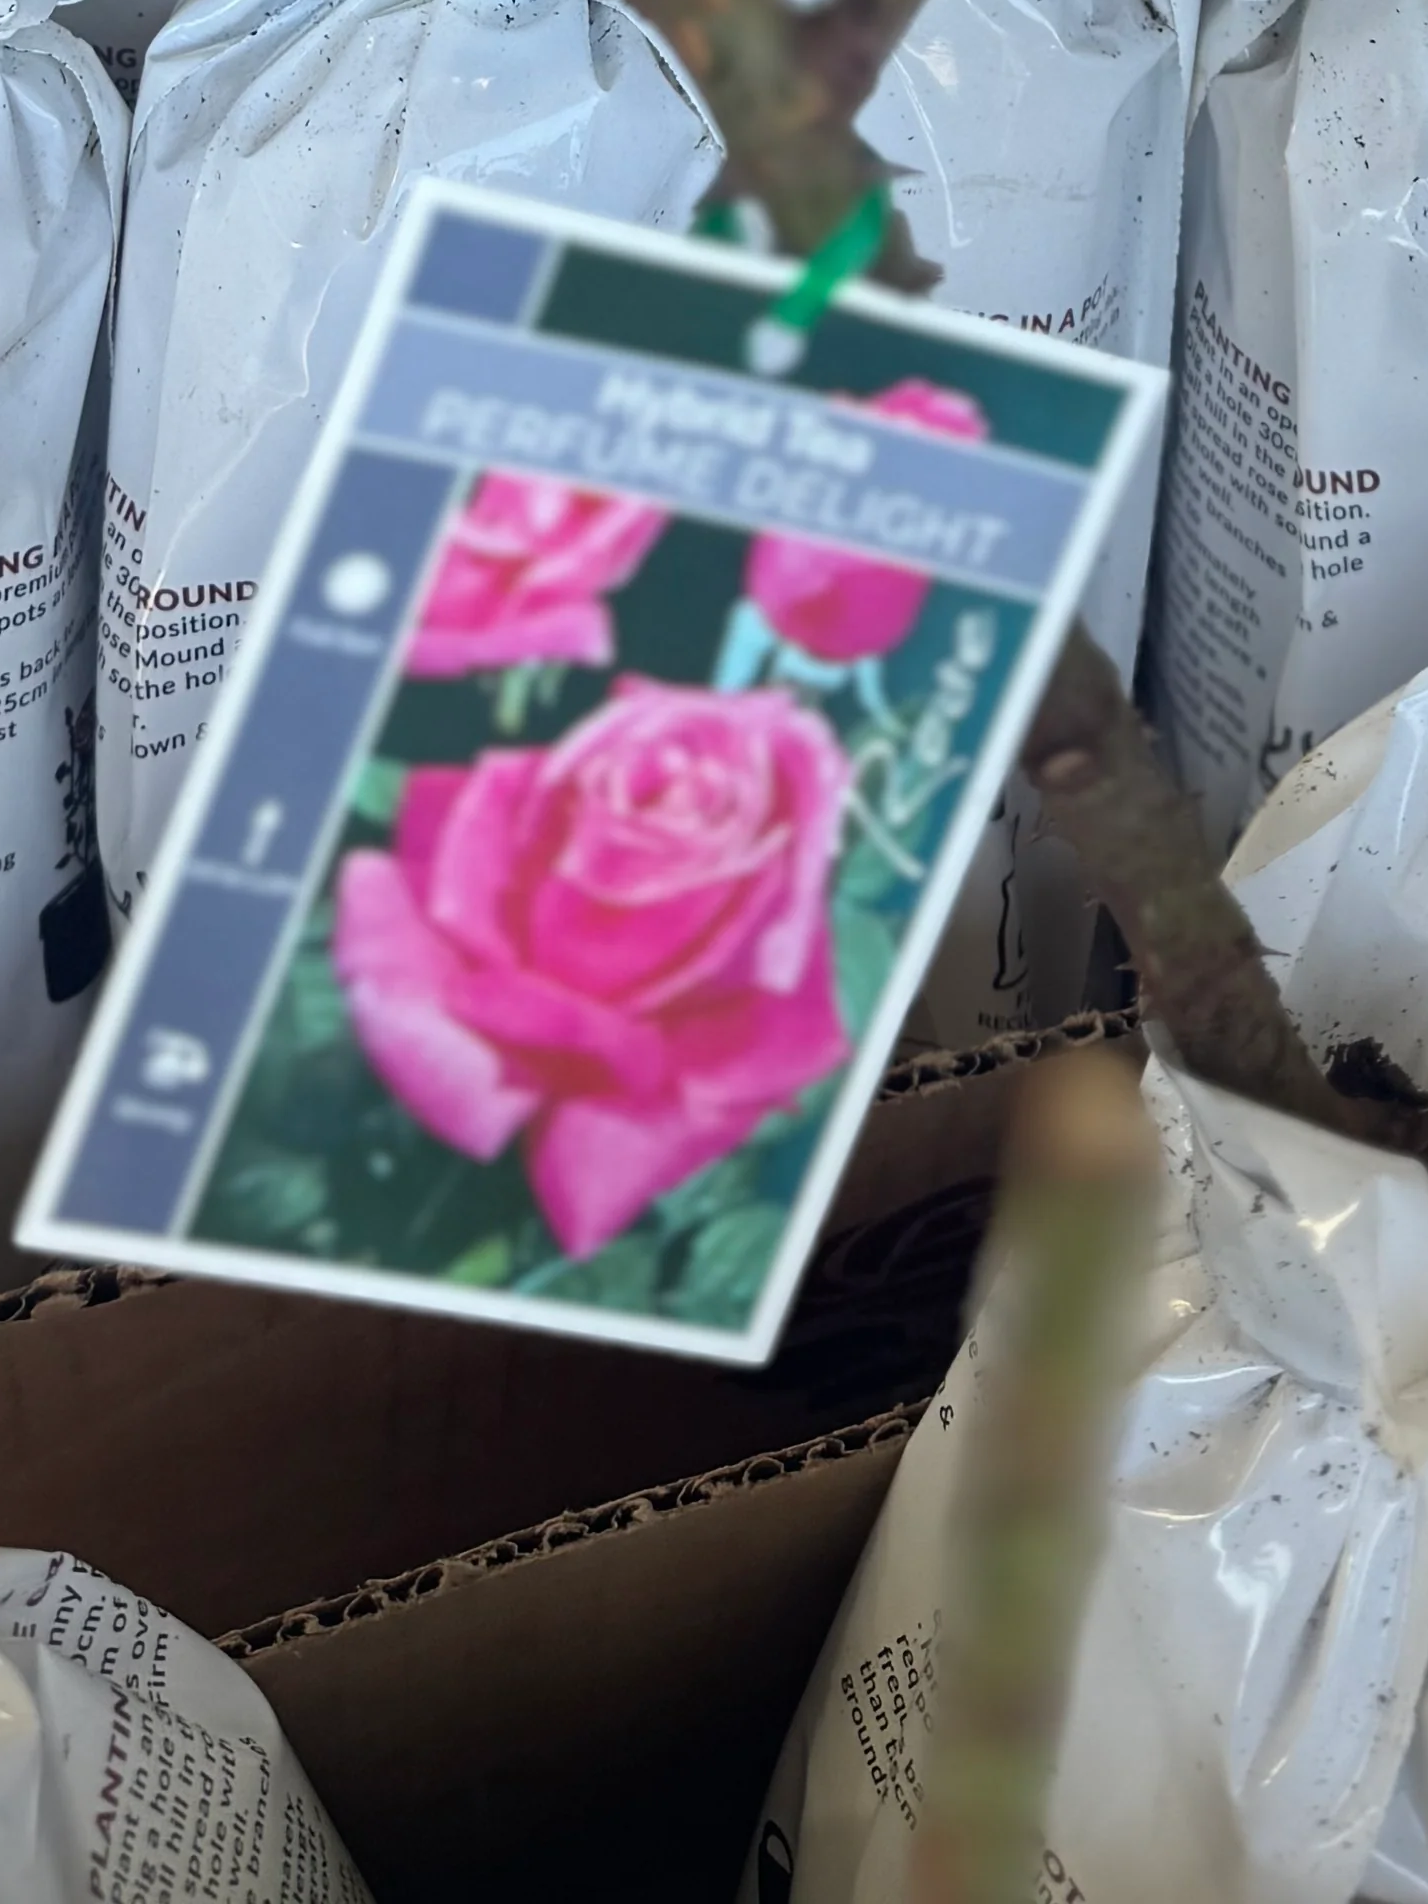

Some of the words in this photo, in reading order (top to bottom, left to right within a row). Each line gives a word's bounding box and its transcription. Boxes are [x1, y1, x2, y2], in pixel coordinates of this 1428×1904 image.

[1194, 279, 1292, 405] PLANTING
[596, 368, 762, 452] Hybrid
[764, 409, 878, 478] Tea
[417, 387, 726, 500] PERFUME
[734, 443, 1012, 569] DELIGHT
[1303, 555, 1364, 579] hole
[18, 643, 62, 684] back
[135, 638, 225, 670] Mound
[135, 679, 176, 700] the
[182, 1770, 215, 1896] spread
